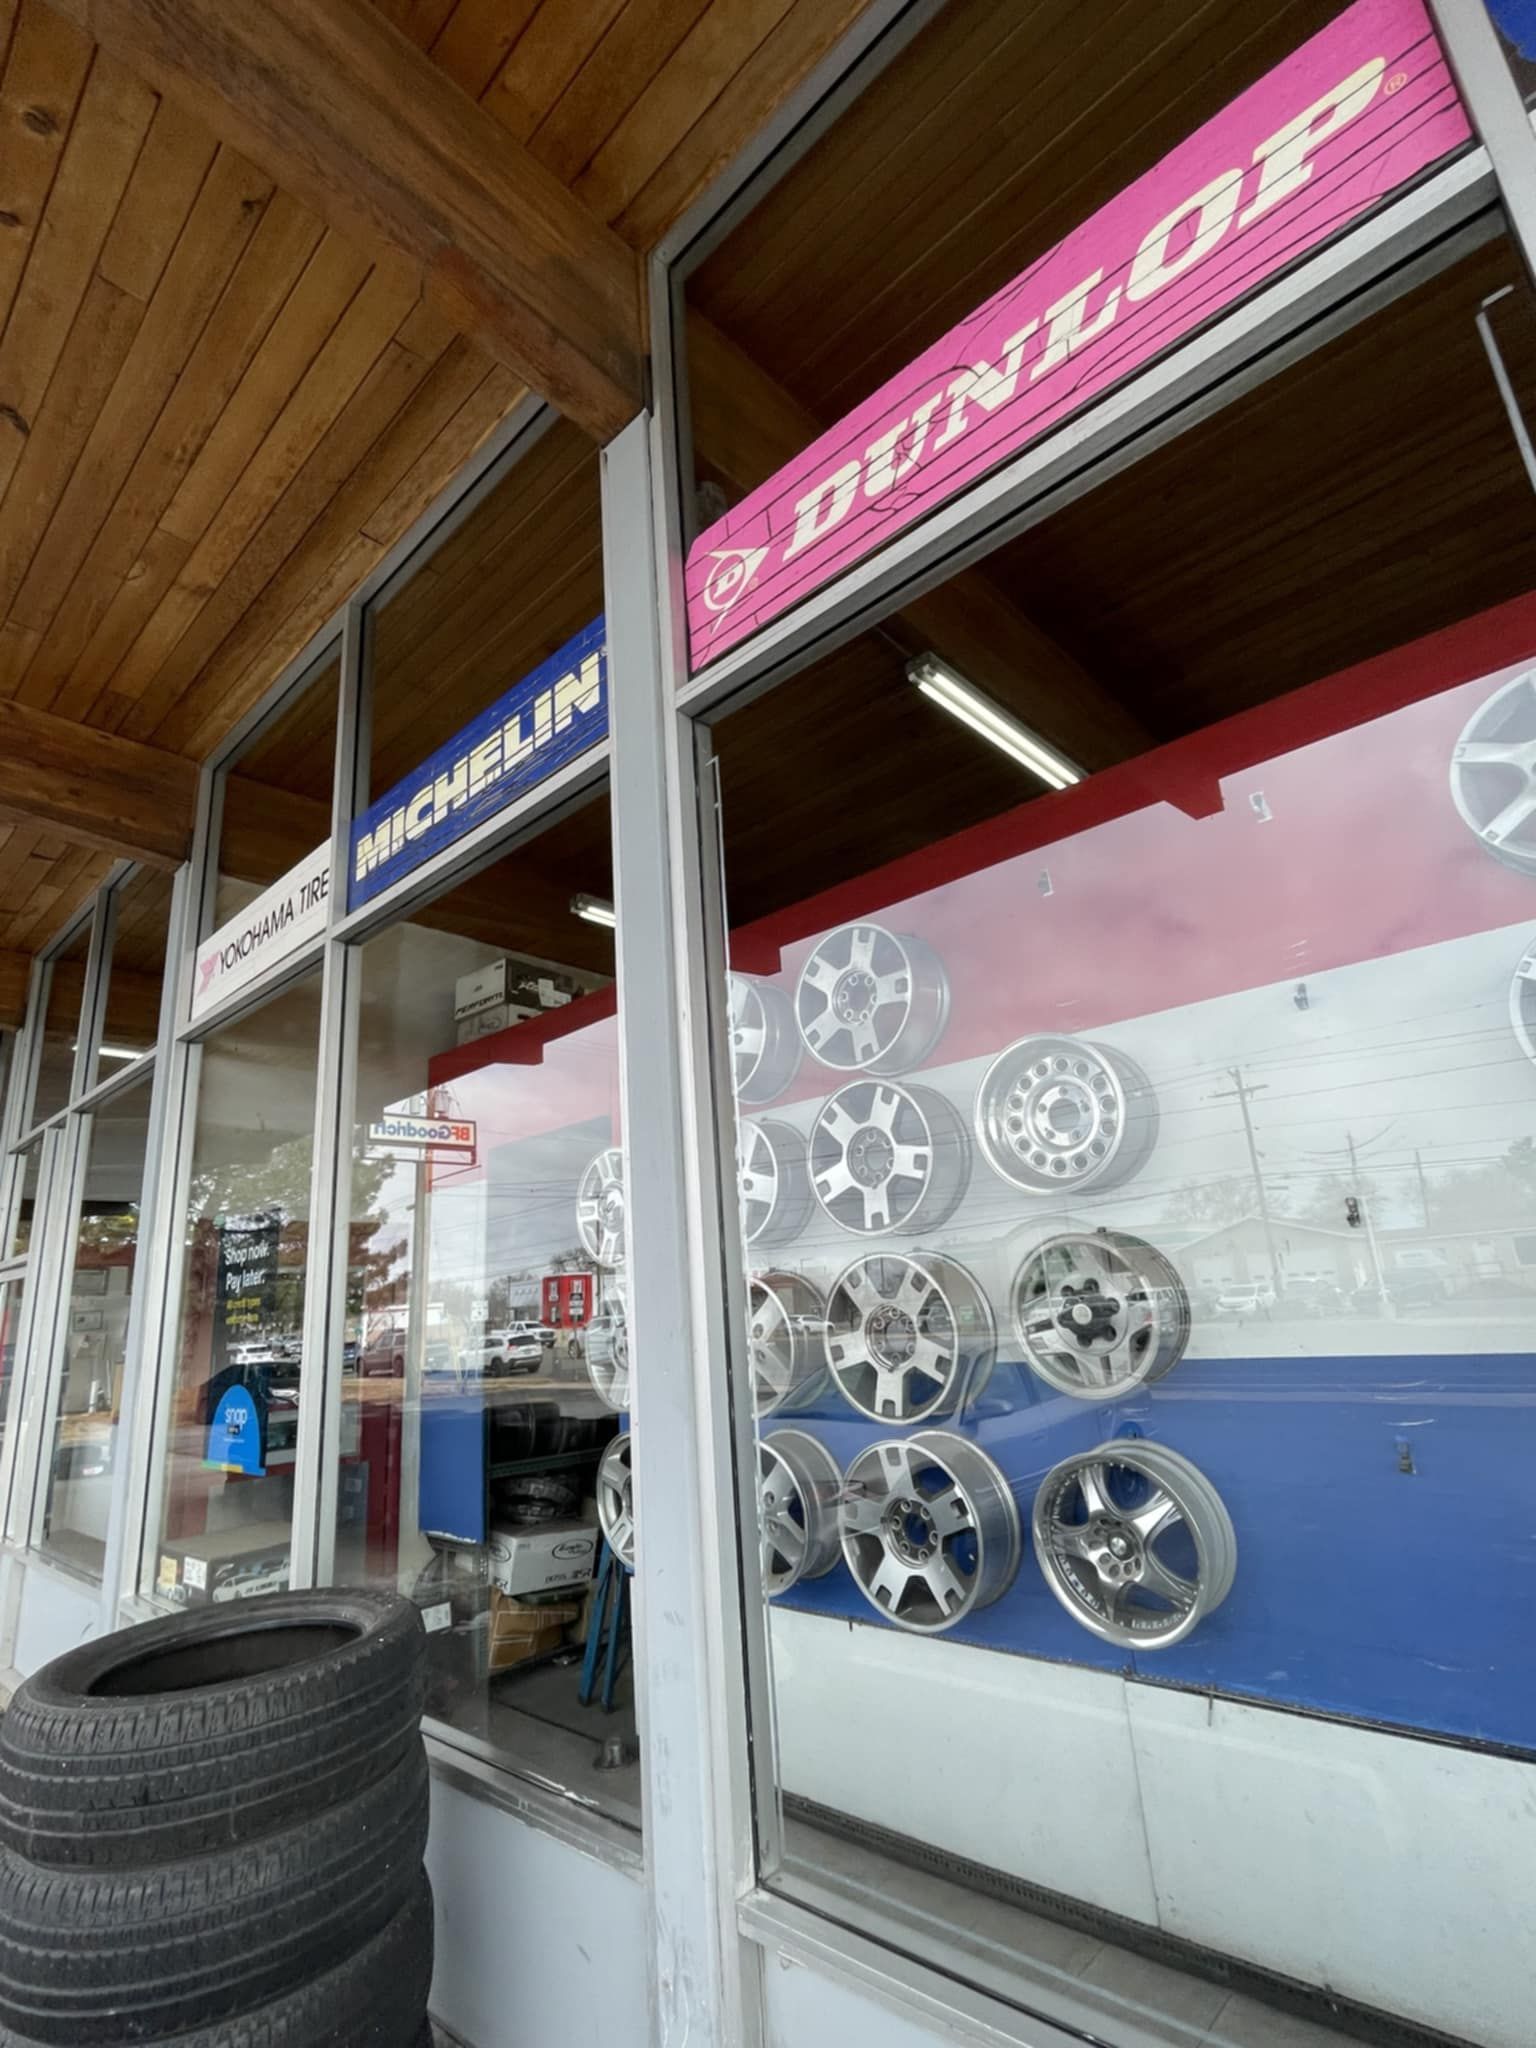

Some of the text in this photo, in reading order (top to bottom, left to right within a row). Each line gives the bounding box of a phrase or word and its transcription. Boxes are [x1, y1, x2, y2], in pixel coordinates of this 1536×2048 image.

[782, 56, 1386, 561] DUNLOP
[355, 651, 601, 883] MICHELIN
[218, 896, 295, 975] YOKOHAMA
[224, 1246, 247, 1267] Shop
[225, 1268, 265, 1293] Pay later.
[225, 1407, 247, 1431] snap
